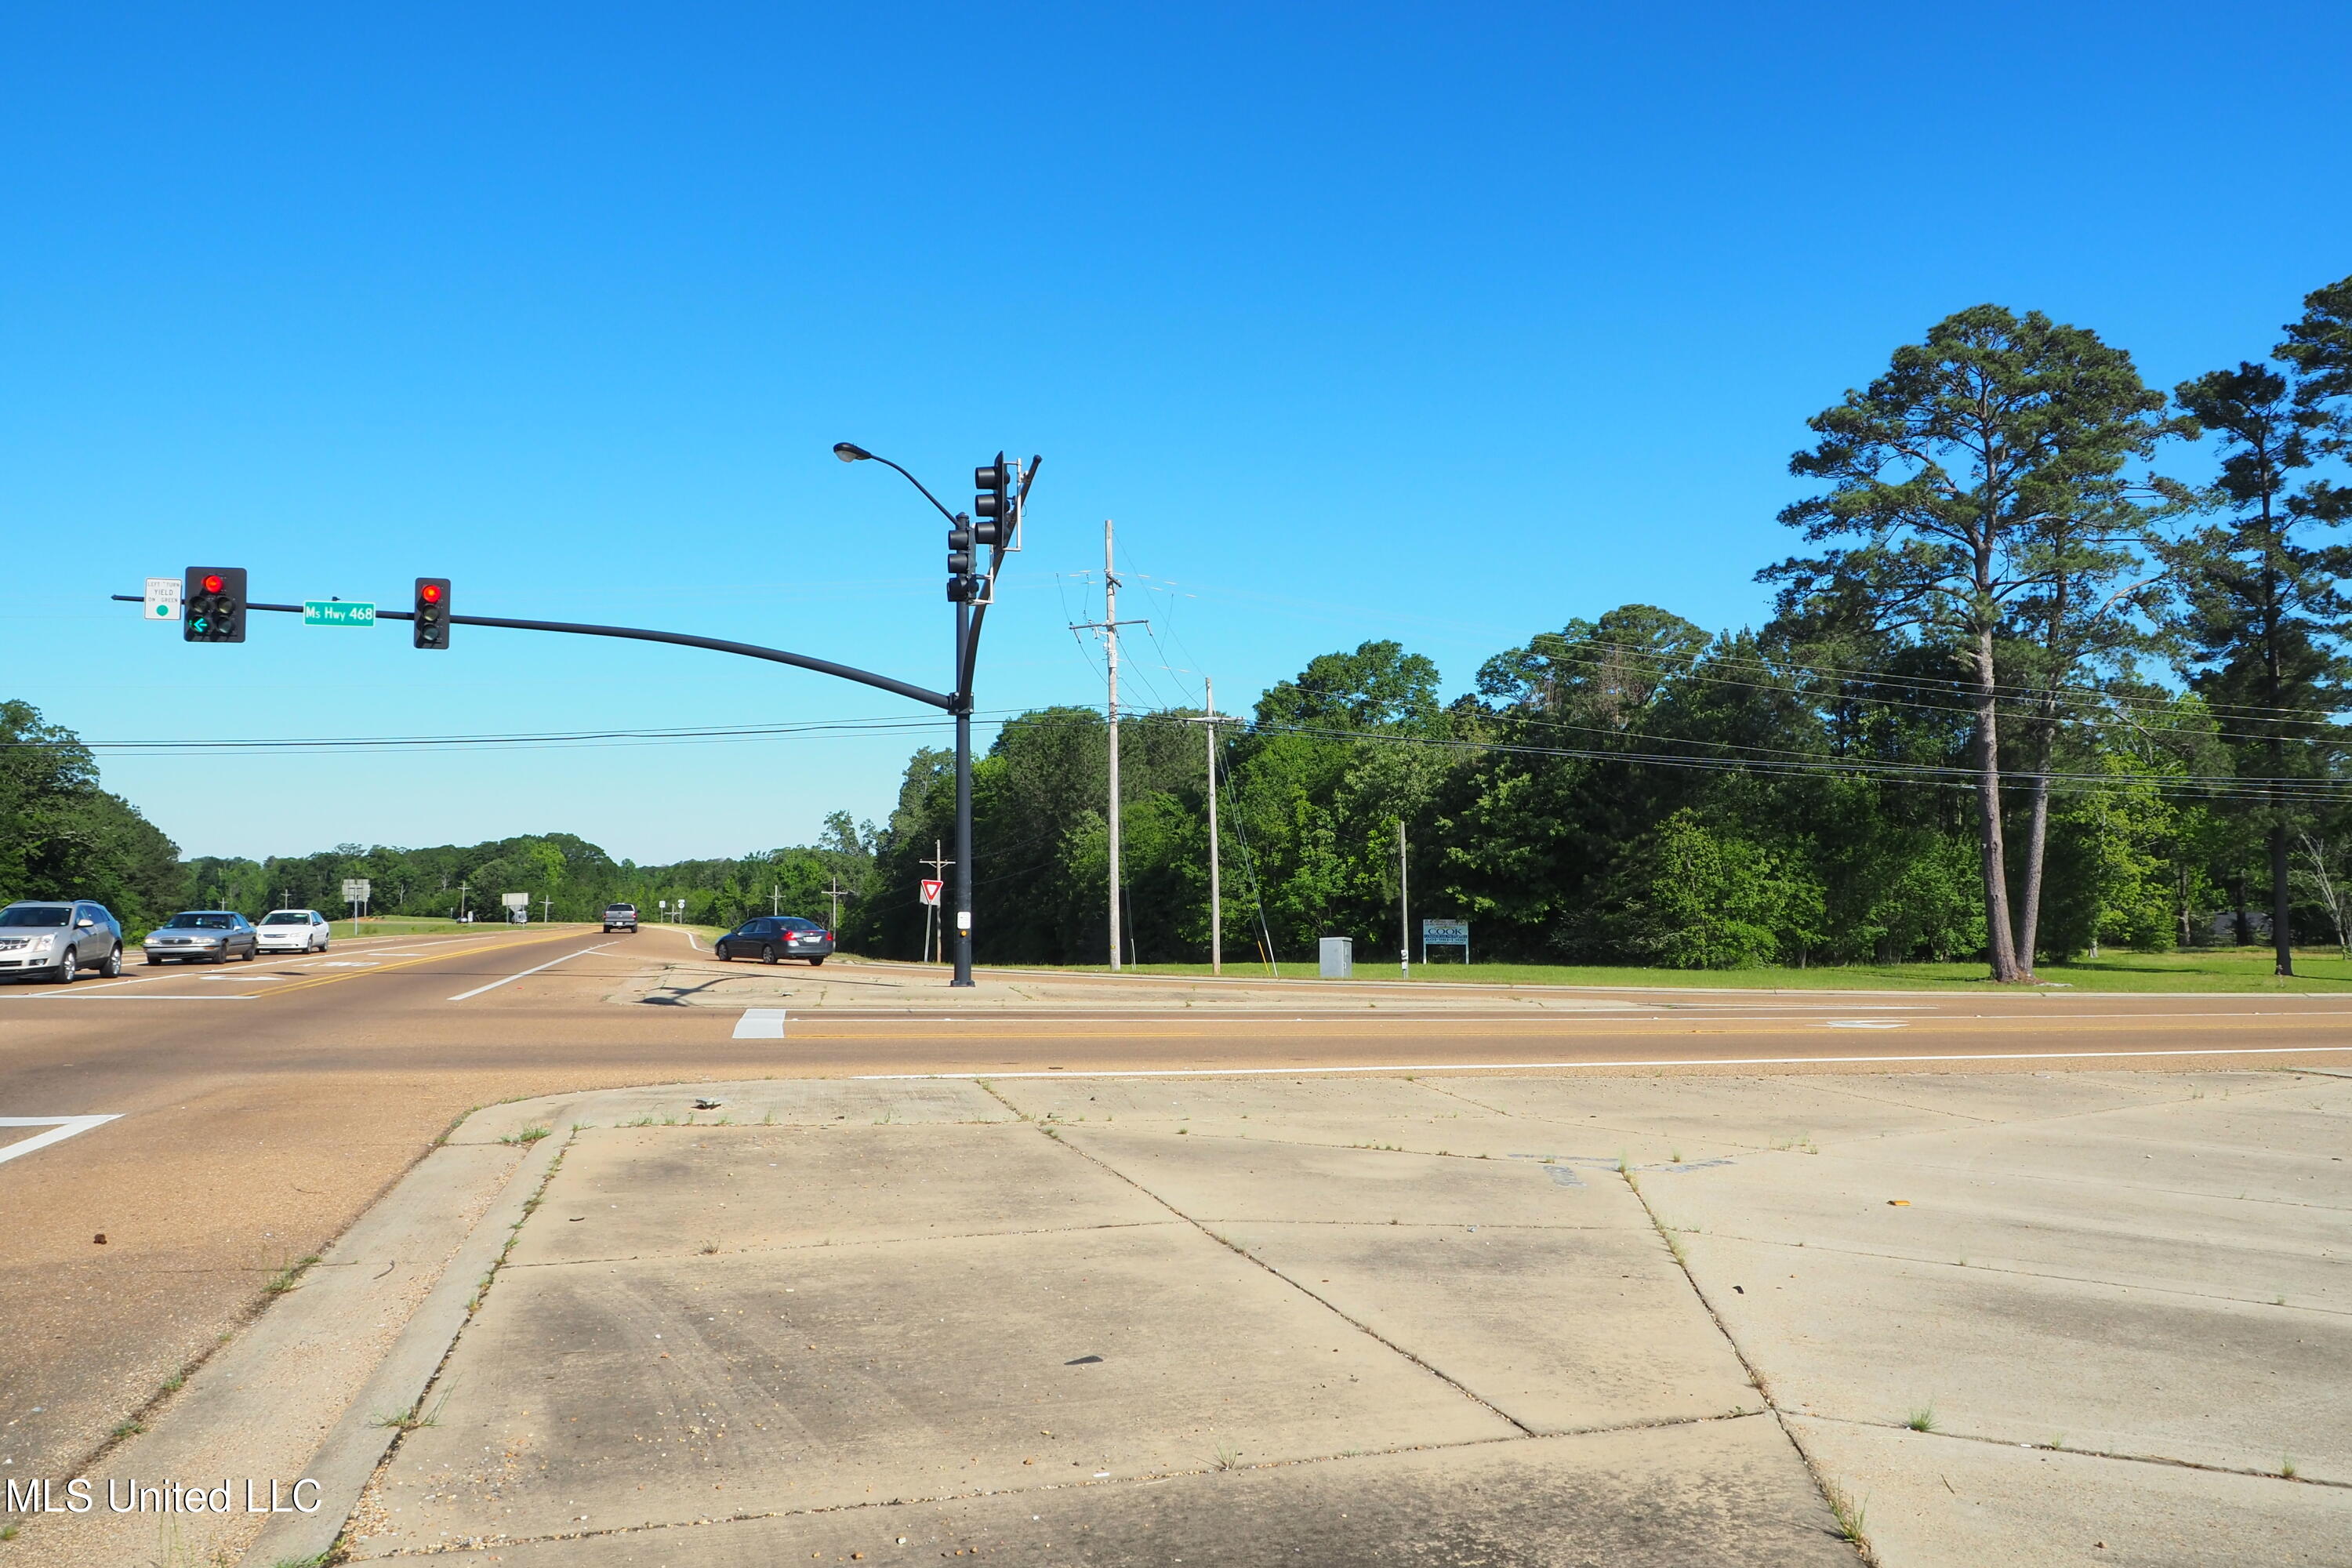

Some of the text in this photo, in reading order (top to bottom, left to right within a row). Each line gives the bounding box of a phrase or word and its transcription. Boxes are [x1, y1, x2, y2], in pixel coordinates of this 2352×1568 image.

[306, 606, 373, 622] Ms Hwy 468
